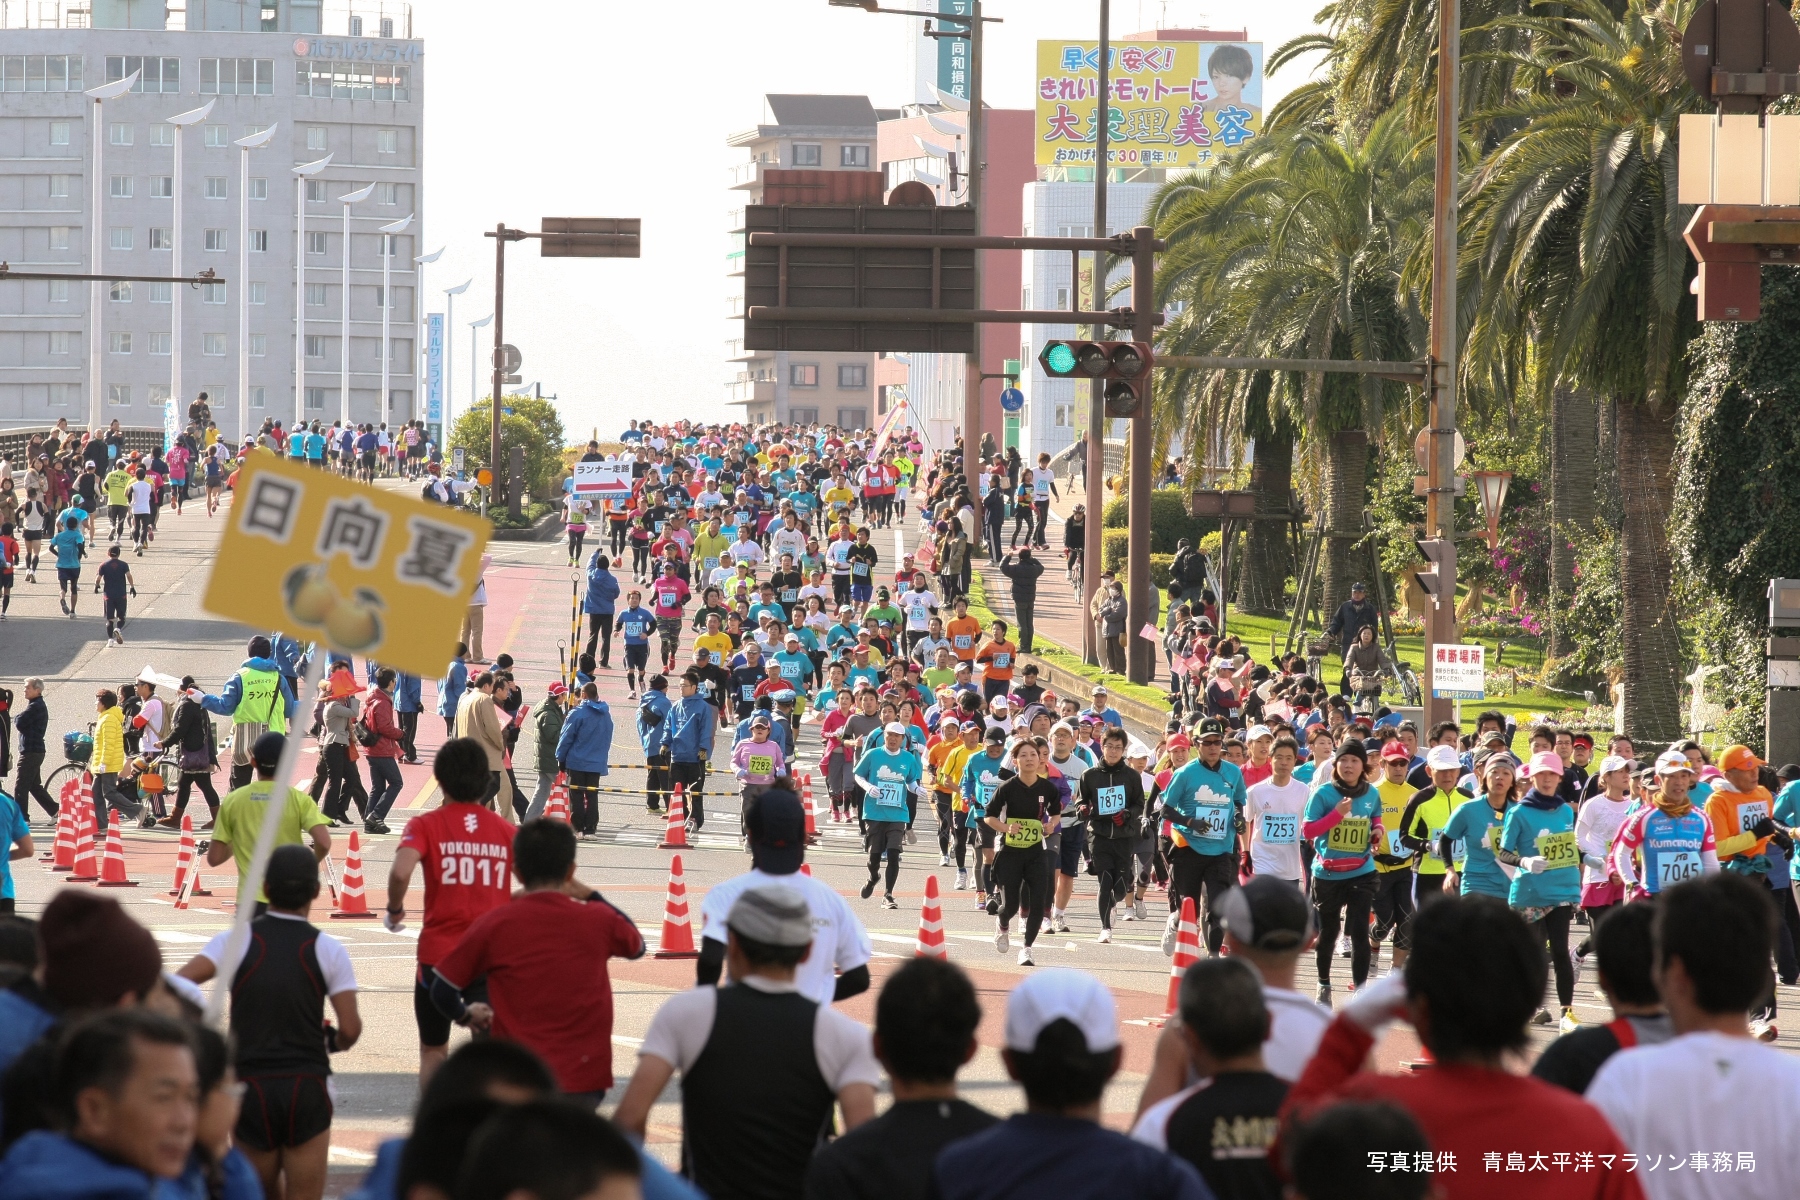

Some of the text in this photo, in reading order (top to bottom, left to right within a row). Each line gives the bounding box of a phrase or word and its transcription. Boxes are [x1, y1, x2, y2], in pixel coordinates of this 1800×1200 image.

[308, 39, 425, 63] ホテルサンライト
[1043, 104, 1255, 147] 大衆理美容
[1055, 148, 1178, 163] おかげで30周年!!
[428, 316, 442, 419] ホテルサンライト宮崎
[577, 464, 630, 475] ランナー走路
[243, 476, 469, 592] 日向夏
[1436, 649, 1480, 664] 横断場所
[782, 664, 798, 673] 7365
[752, 761, 770, 771] 7282
[880, 789, 900, 802] 5771
[1100, 794, 1124, 809] 7879
[1747, 804, 1762, 813] ANA
[1266, 823, 1295, 838] 7253
[1332, 827, 1364, 845] 8101
[1546, 836, 1562, 844] ANA
[1649, 838, 1703, 850] Kumamoto
[439, 842, 508, 860] YOKOHAMA
[1543, 842, 1575, 861] 8935
[441, 856, 506, 889] 2011
[1662, 863, 1699, 881] 7045
